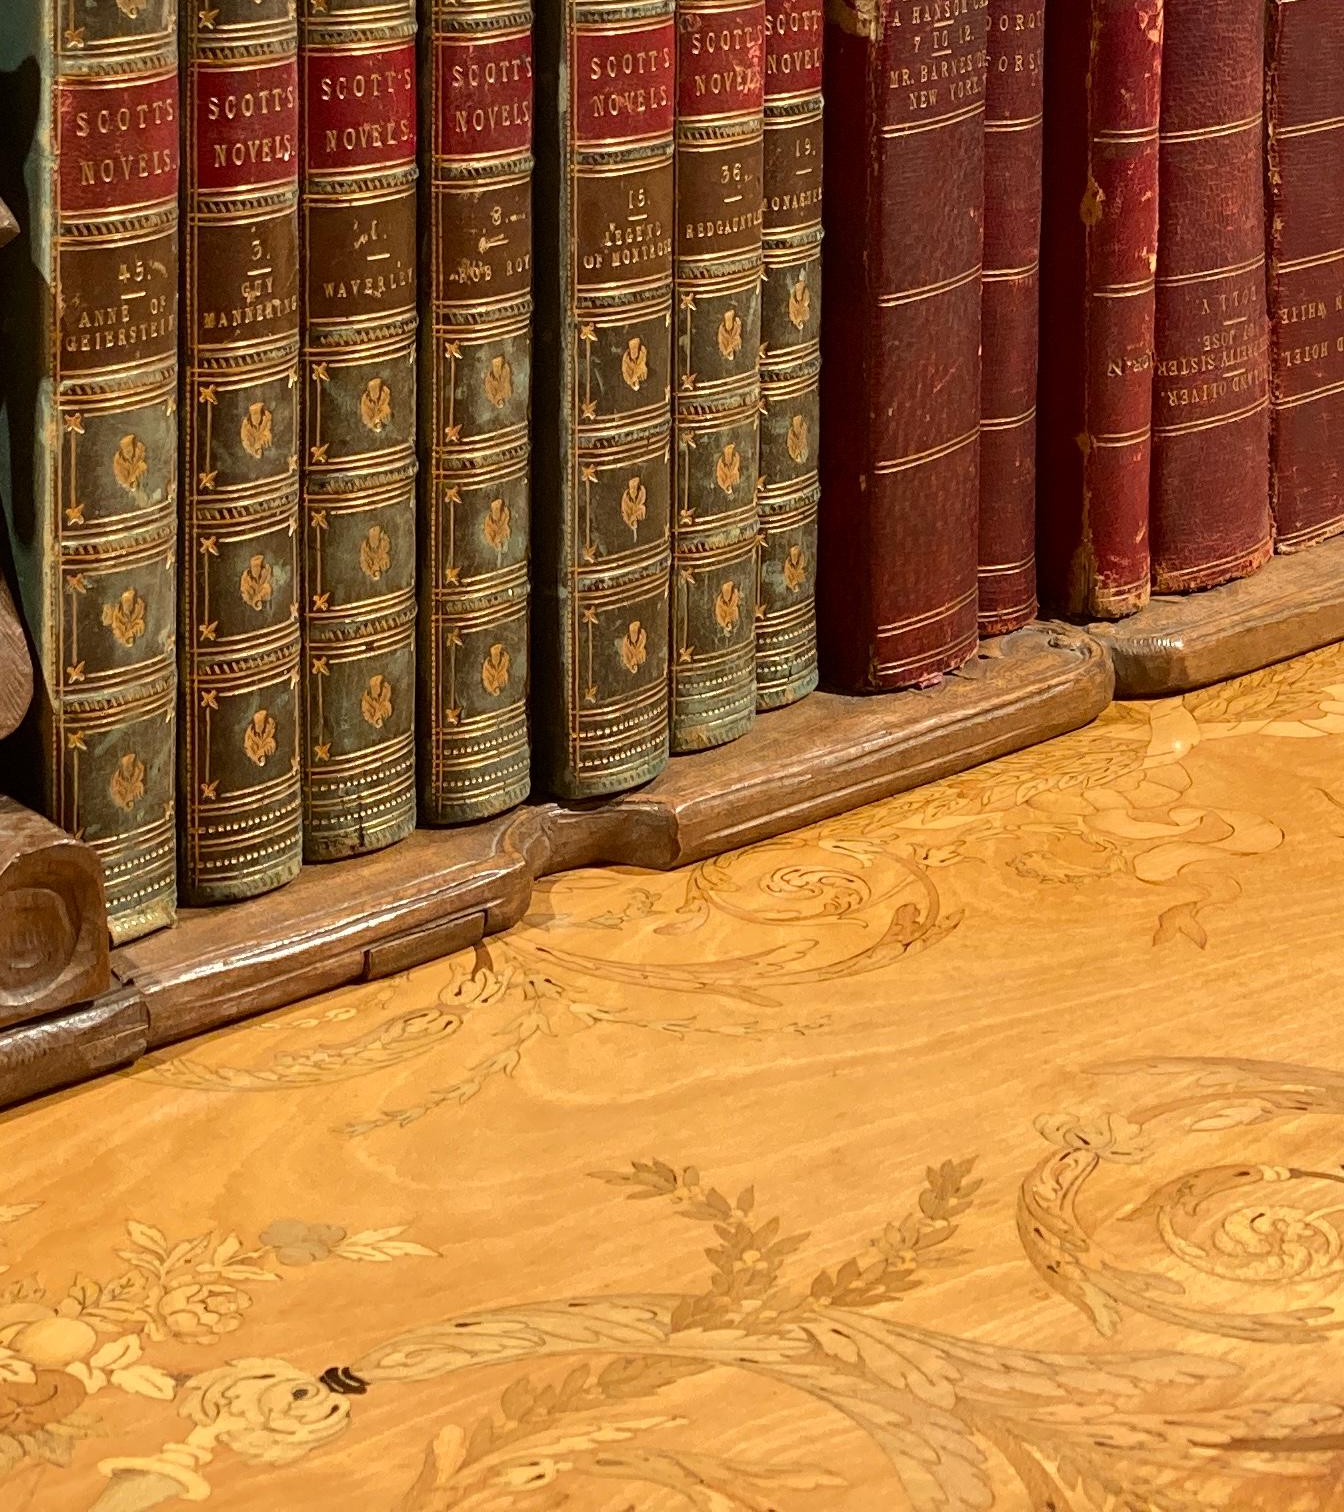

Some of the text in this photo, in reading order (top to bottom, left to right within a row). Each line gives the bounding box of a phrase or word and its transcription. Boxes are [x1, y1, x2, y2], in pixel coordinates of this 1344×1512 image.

[892, 10, 901, 26] A
[914, 36, 921, 52] 7
[933, 30, 948, 48] TO
[321, 68, 412, 100] SCOTT'S
[890, 69, 914, 88] MR.
[921, 55, 972, 82] BARNES
[208, 86, 294, 120] SCOTT'S
[909, 89, 937, 110] NEW
[214, 134, 296, 168] NOVELS.
[325, 119, 416, 153] NOVELS.
[80, 149, 177, 185] NOVELS.
[241, 276, 273, 298] GUY
[323, 267, 413, 297] WAVERLEY
[78, 304, 130, 328] ANNE
[1281, 341, 1328, 367] HOTEL.
